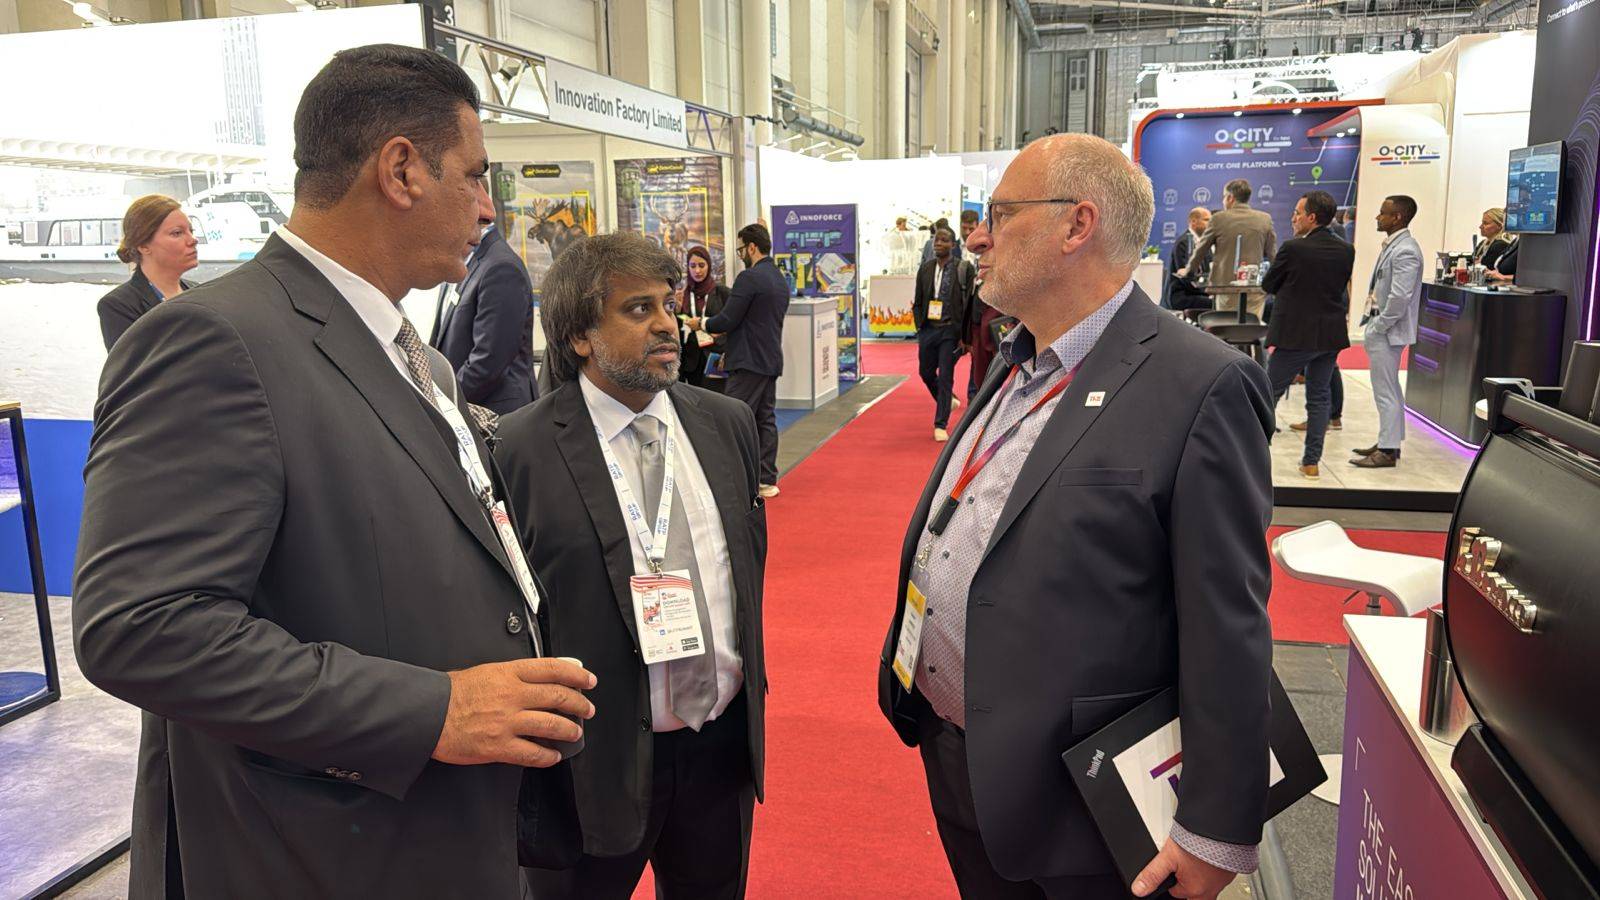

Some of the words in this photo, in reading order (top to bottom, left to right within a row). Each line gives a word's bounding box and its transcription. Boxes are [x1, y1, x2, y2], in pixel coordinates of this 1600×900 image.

[444, 5, 454, 26] 3
[554, 80, 614, 117] Innovation
[615, 98, 651, 130] Factory
[652, 107, 683, 133] Limited
[1191, 163, 1207, 171] ONE
[1225, 162, 1241, 170] ONE
[800, 213, 843, 222] INNOFORCE
[627, 503, 638, 521] RATP
[1086, 748, 1105, 779] ThinkPad
[1363, 788, 1385, 867] THE
